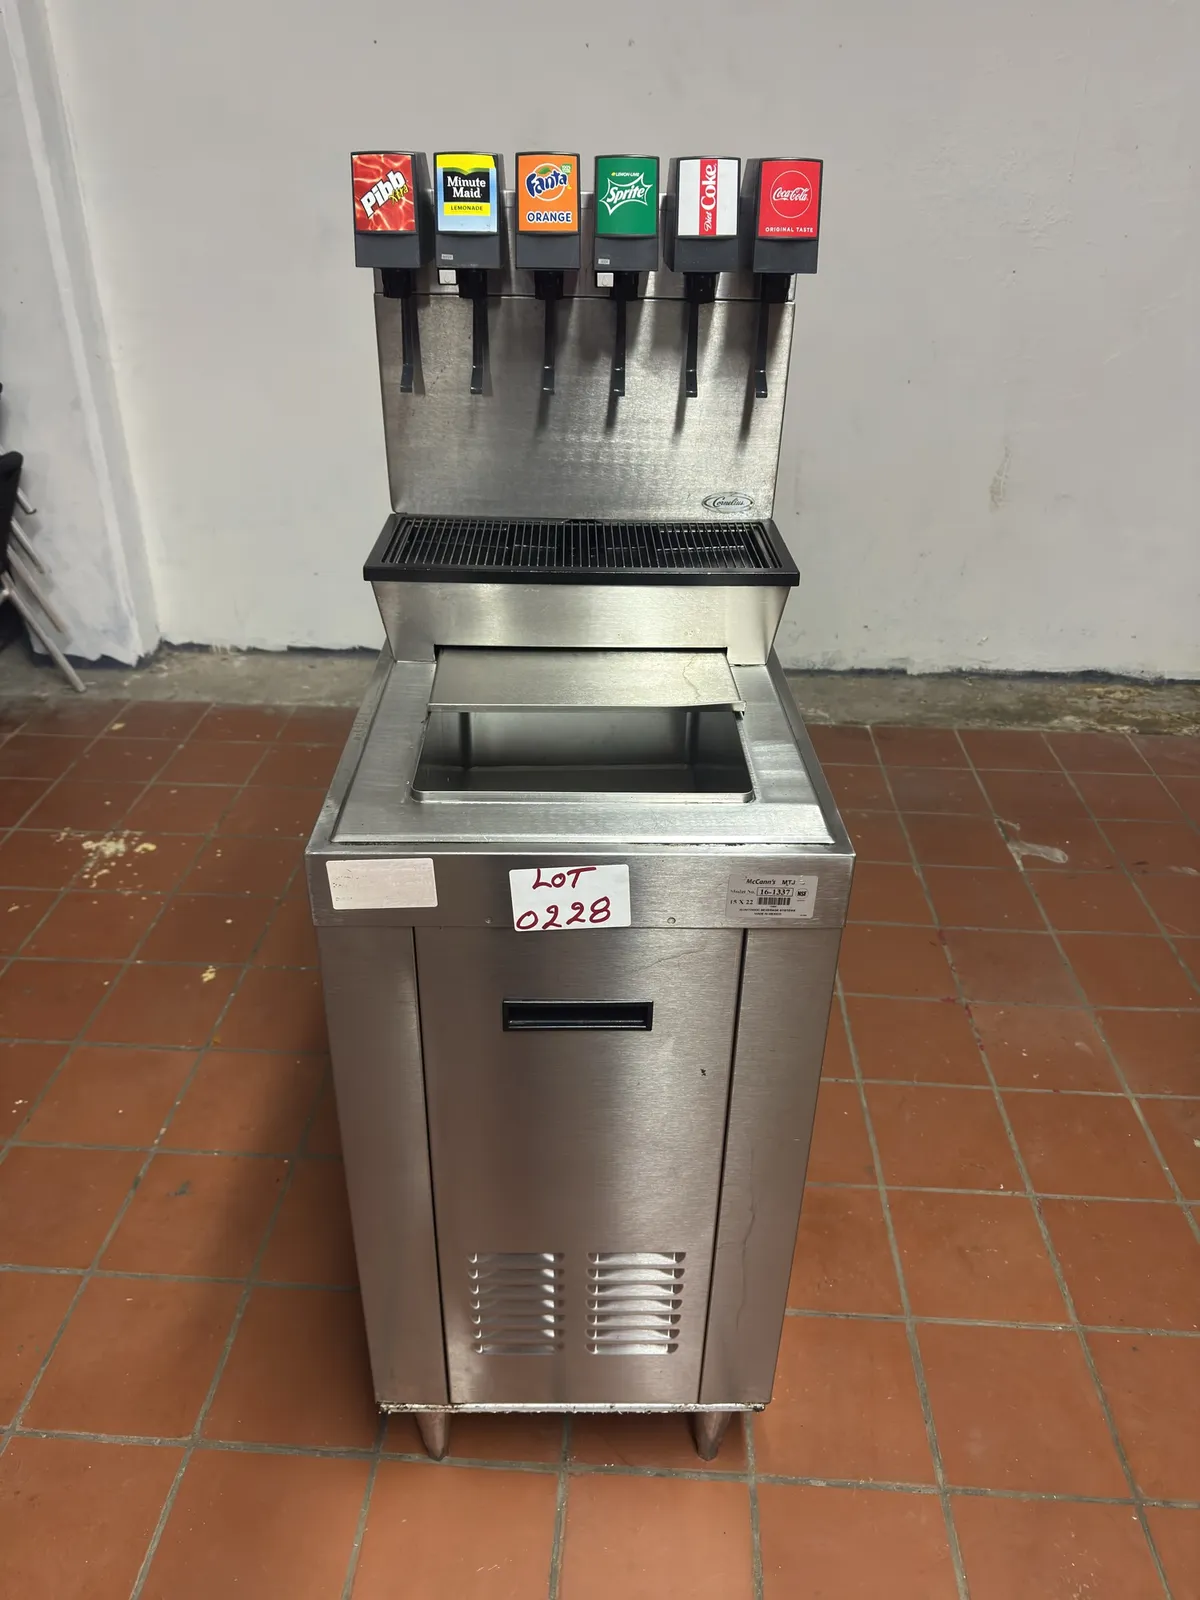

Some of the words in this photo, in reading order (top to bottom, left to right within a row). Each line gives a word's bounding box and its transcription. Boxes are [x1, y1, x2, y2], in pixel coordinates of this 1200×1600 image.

[447, 176, 486, 187] Minute
[525, 169, 568, 198] Fanta
[700, 163, 717, 211] Coke
[360, 170, 406, 218] Pibb
[453, 187, 481, 198] Maid
[606, 185, 646, 204] Sprite
[773, 187, 810, 201] Coca-Cola
[526, 211, 572, 223] ORANGE
[703, 211, 713, 232] Diet
[745, 878, 776, 886] McCann's
[760, 888, 791, 896] 16-1337
[516, 896, 611, 930] 0228
